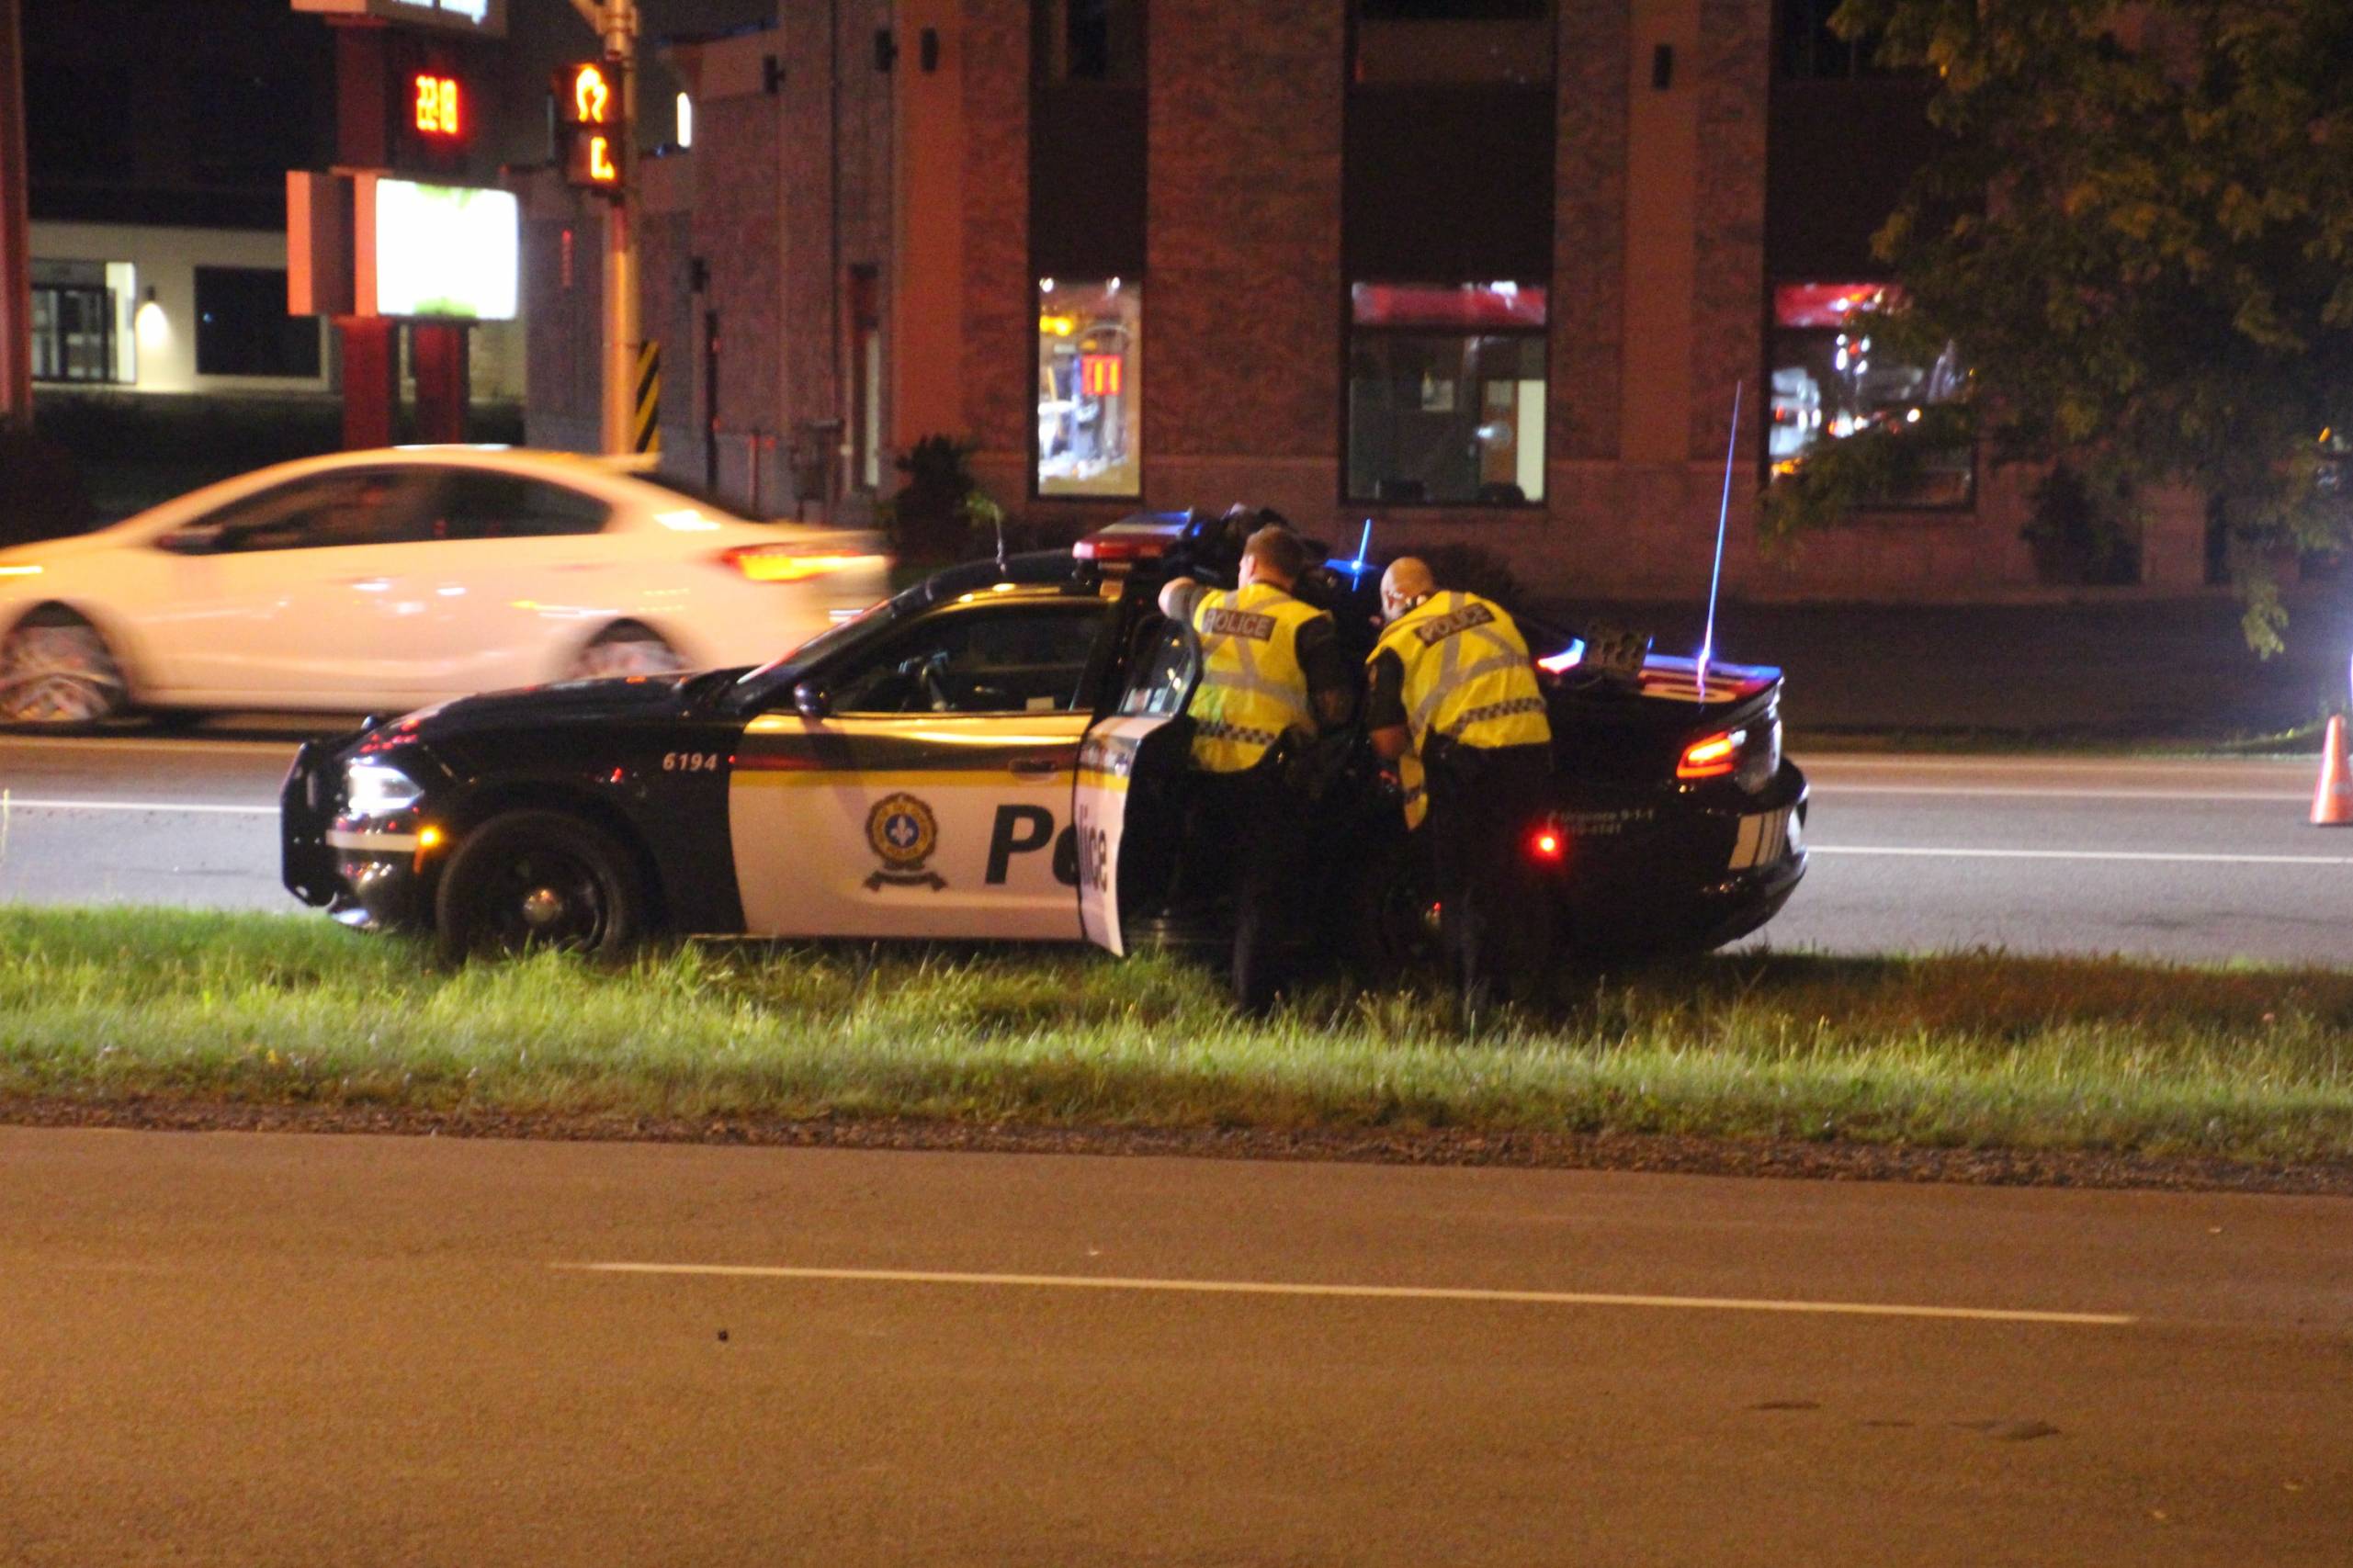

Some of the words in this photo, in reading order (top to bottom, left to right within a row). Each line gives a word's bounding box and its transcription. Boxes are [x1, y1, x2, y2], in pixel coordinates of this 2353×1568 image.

[1203, 609, 1269, 638] POLICE
[1420, 605, 1487, 641] POLICE
[662, 752, 718, 771] 6194
